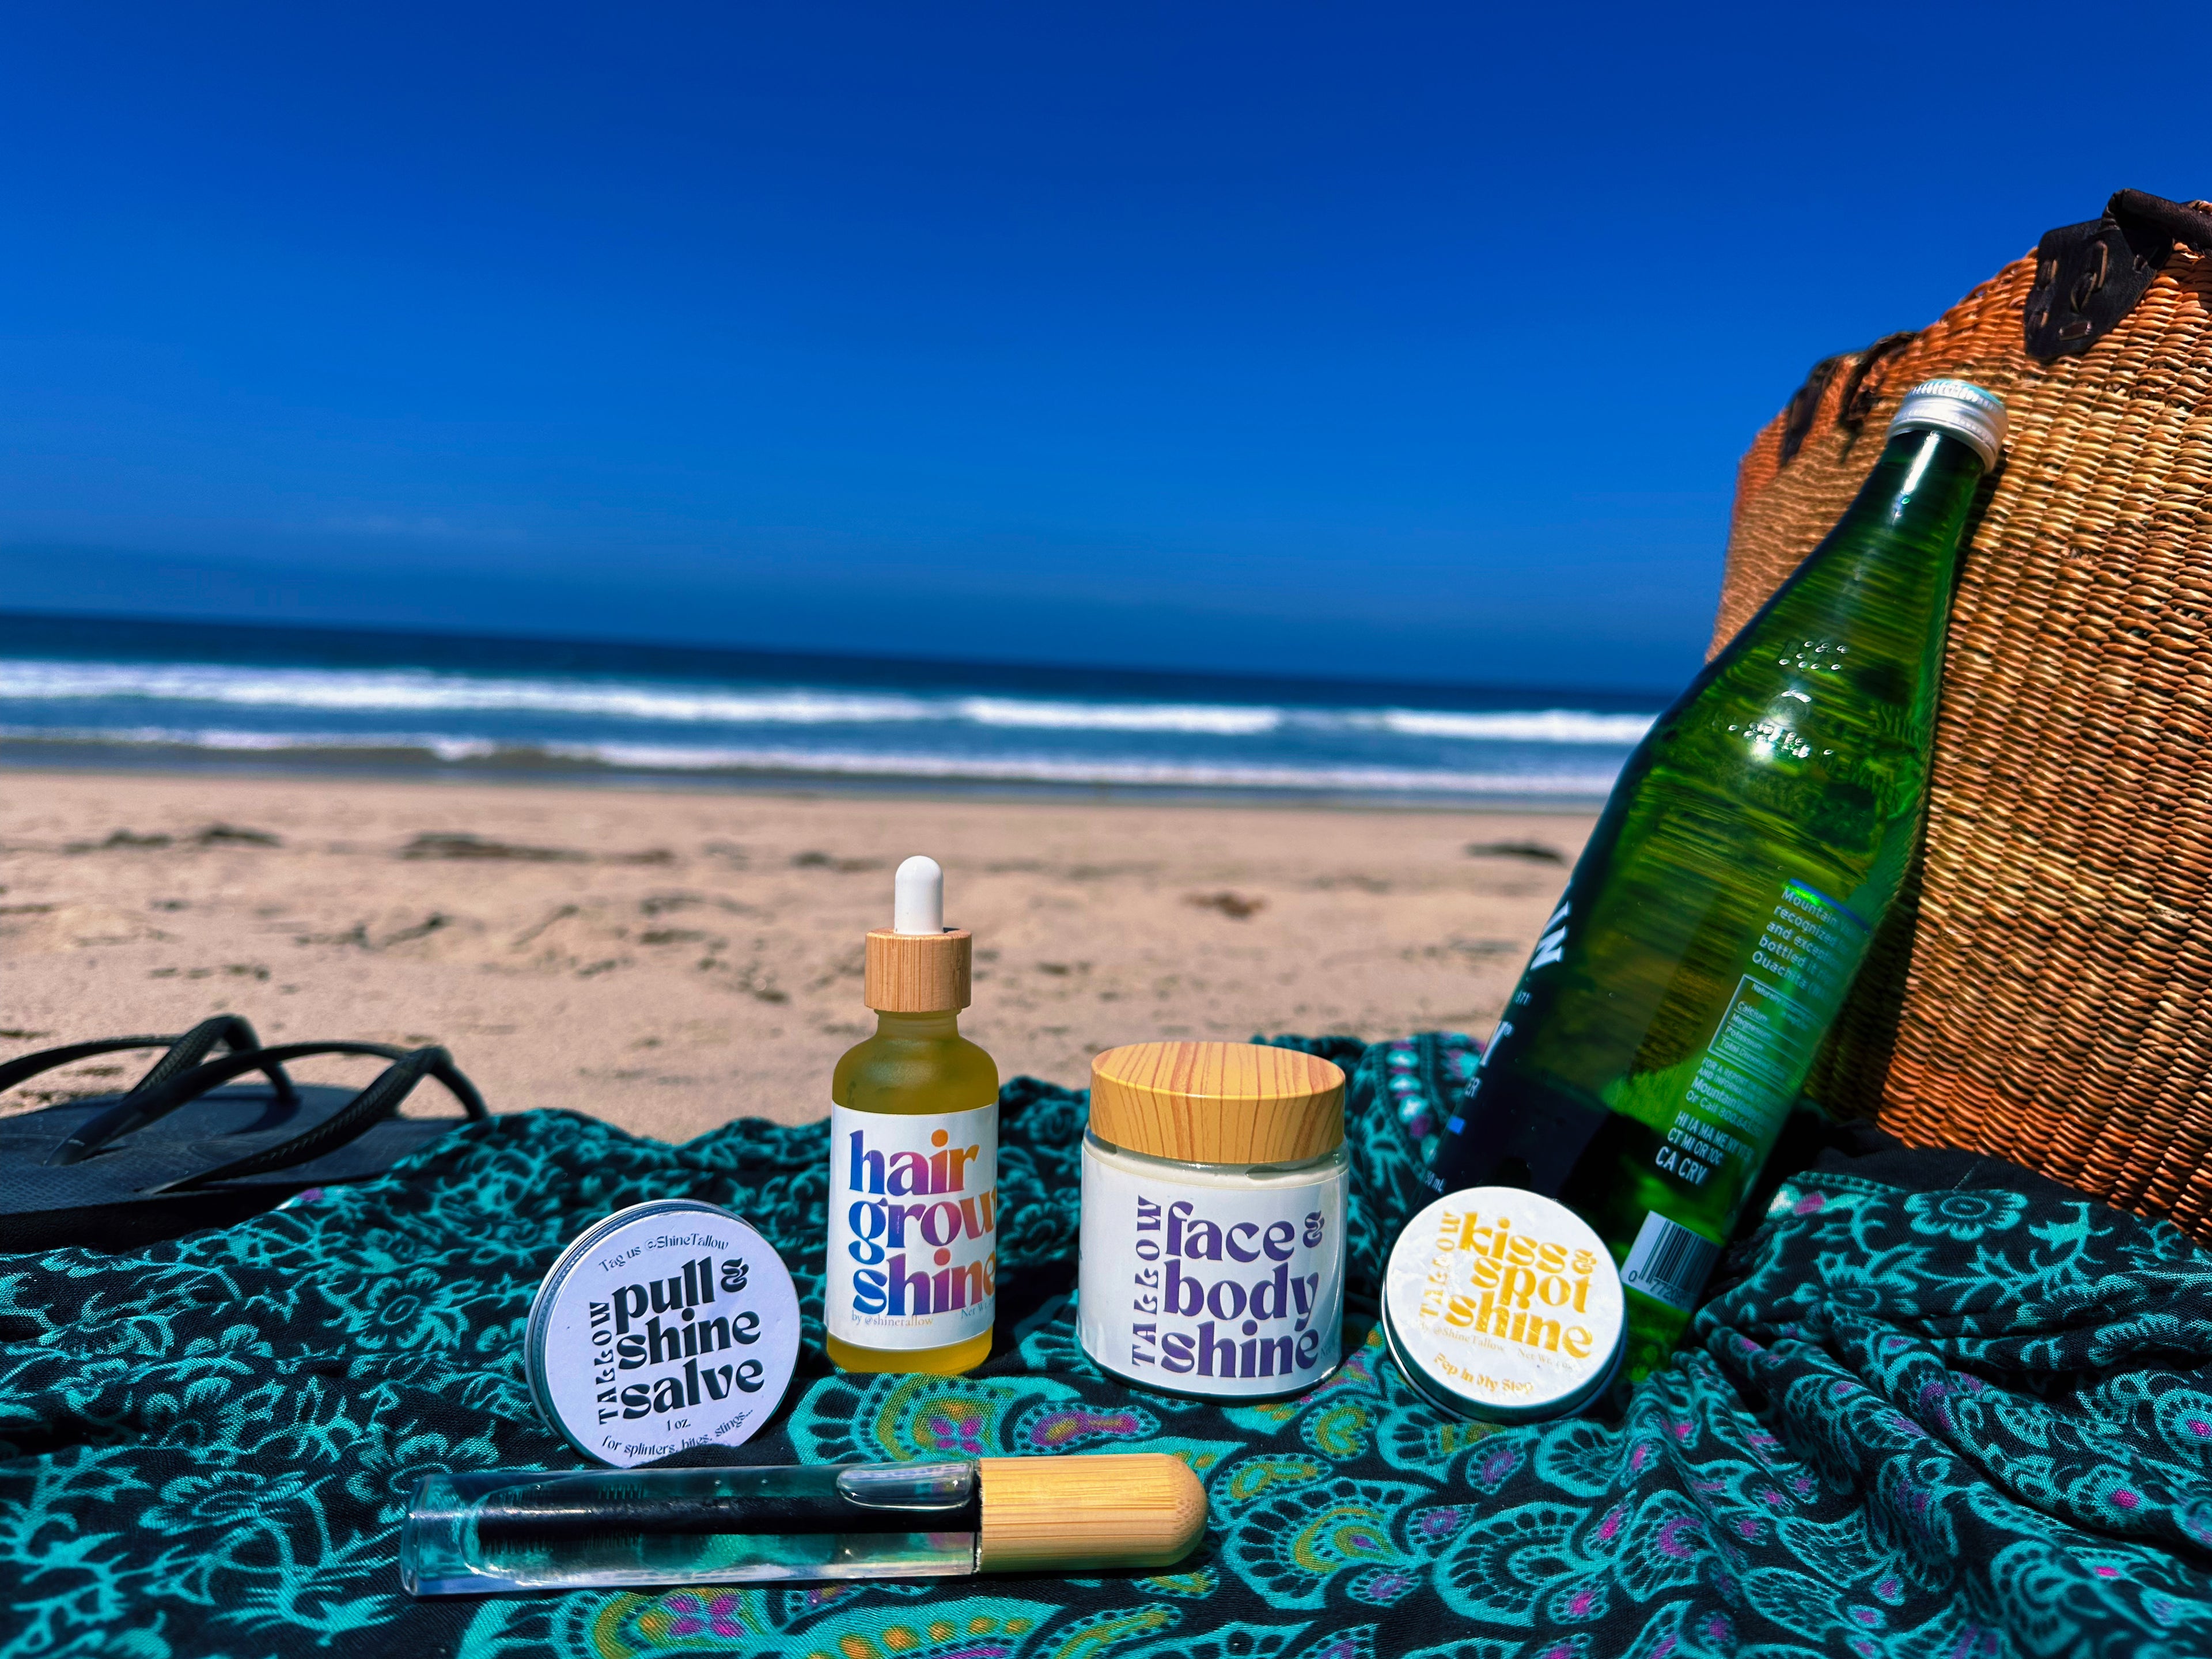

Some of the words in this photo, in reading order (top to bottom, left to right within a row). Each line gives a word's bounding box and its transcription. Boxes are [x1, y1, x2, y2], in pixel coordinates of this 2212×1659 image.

[1774, 905, 1838, 948] recognized
[1782, 888, 1838, 927] Mountain
[1759, 934, 1808, 968] bottled
[1766, 921, 1794, 941] and
[1752, 950, 1809, 990] Ouachita
[1685, 1090, 1699, 1104] Or
[1700, 1097, 1719, 1115] Call
[1668, 1127, 1683, 1145] CT
[1680, 1134, 1696, 1151] MI
[1694, 1140, 1709, 1159] OR
[1675, 1110, 1690, 1127] HI
[1698, 1123, 1715, 1142] MA
[849, 1129, 979, 1196] hair
[1656, 1146, 1678, 1173] CA
[1678, 1157, 1707, 1185] CRV
[849, 1187, 996, 1265] grow
[1165, 1200, 1295, 1262] face
[1303, 1210, 1325, 1248] &
[1458, 1211, 1568, 1274] kiss
[1571, 1248, 1597, 1275] &
[599, 1255, 626, 1272] Tag
[627, 1246, 642, 1259] us
[645, 1233, 729, 1251] @ShineTallow
[612, 1256, 715, 1336] pull
[721, 1257, 749, 1293] &
[853, 1247, 995, 1316] shine
[1131, 1195, 1162, 1367] TALLOW
[1164, 1258, 1319, 1331] body
[1470, 1256, 1591, 1314] spot
[1628, 1270, 1638, 1282] 0
[852, 1310, 862, 1323] by
[1444, 1290, 1593, 1359] shine
[616, 1307, 761, 1370] shine
[1161, 1319, 1319, 1378] shine
[589, 1301, 619, 1425] TALLOW
[1433, 1352, 1458, 1376] Pep
[1476, 1373, 1498, 1392] My
[1502, 1378, 1534, 1395] Step
[621, 1358, 764, 1420] salve
[602, 1435, 622, 1451] for
[666, 1419, 672, 1431] 1
[675, 1419, 691, 1430] oz.
